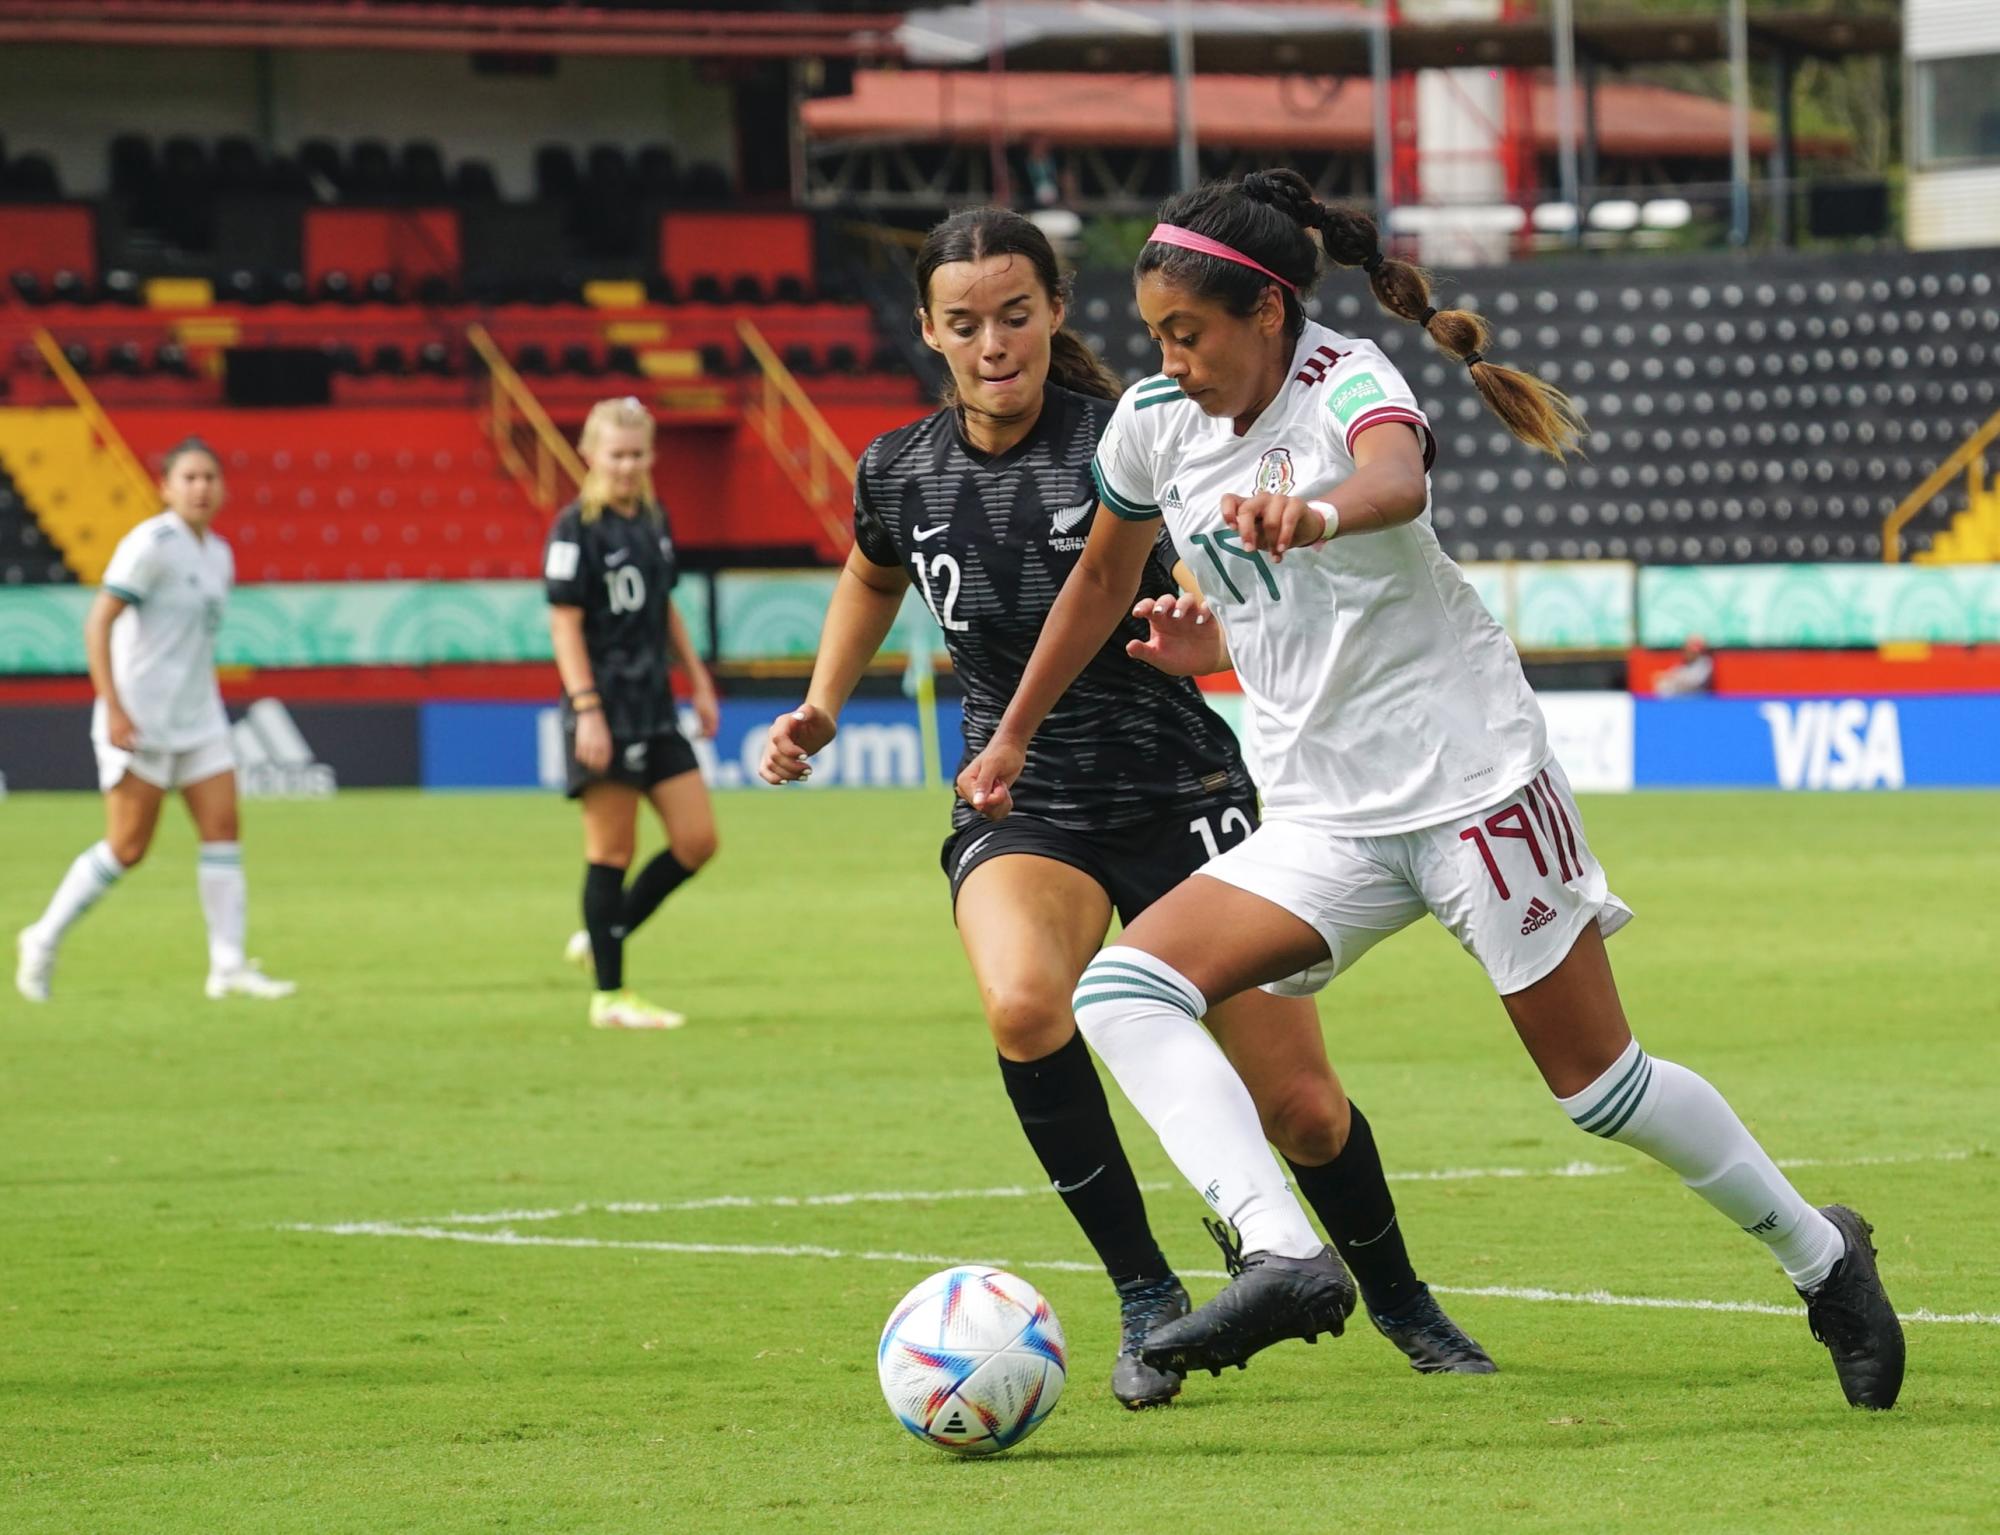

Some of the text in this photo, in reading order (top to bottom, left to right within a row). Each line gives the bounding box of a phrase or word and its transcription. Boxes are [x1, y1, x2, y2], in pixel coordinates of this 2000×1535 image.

[603, 564, 647, 615] 10
[911, 552, 969, 631] 12
[1190, 527, 1281, 605] 19
[1760, 698, 1906, 791] VISA
[1459, 803, 1548, 900] 19
[1520, 908, 1557, 936] adidas
